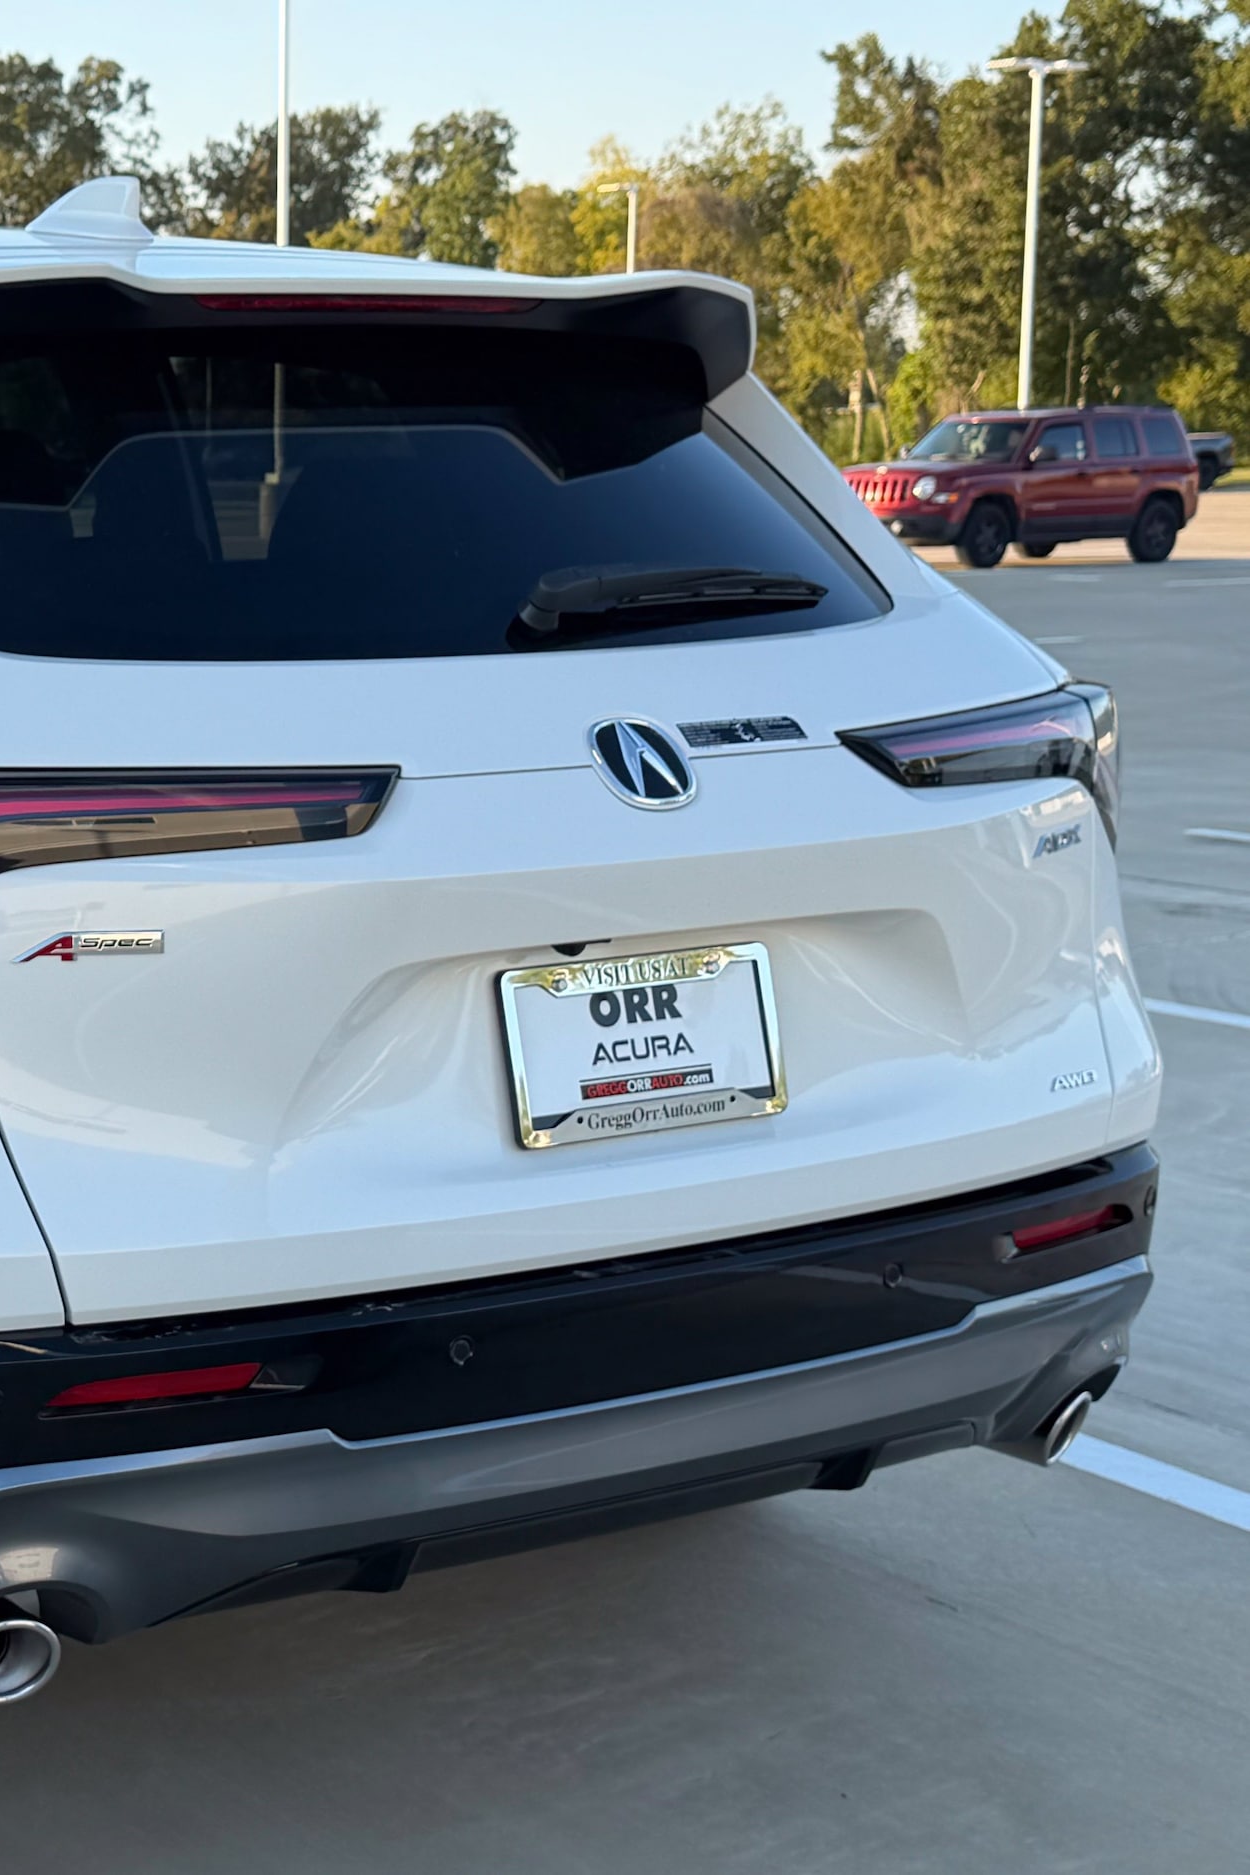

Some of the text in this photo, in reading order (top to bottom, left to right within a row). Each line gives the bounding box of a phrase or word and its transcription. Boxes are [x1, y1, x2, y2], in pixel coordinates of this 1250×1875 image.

[583, 957, 689, 988] VISIT US AT
[589, 984, 682, 1027] ORR
[593, 1033, 694, 1066] ACURA
[587, 1073, 711, 1098] GREGGORRAUTO.com
[1050, 1069, 1096, 1093] AWD
[587, 1099, 726, 1130] GreggOrrAuto.com
